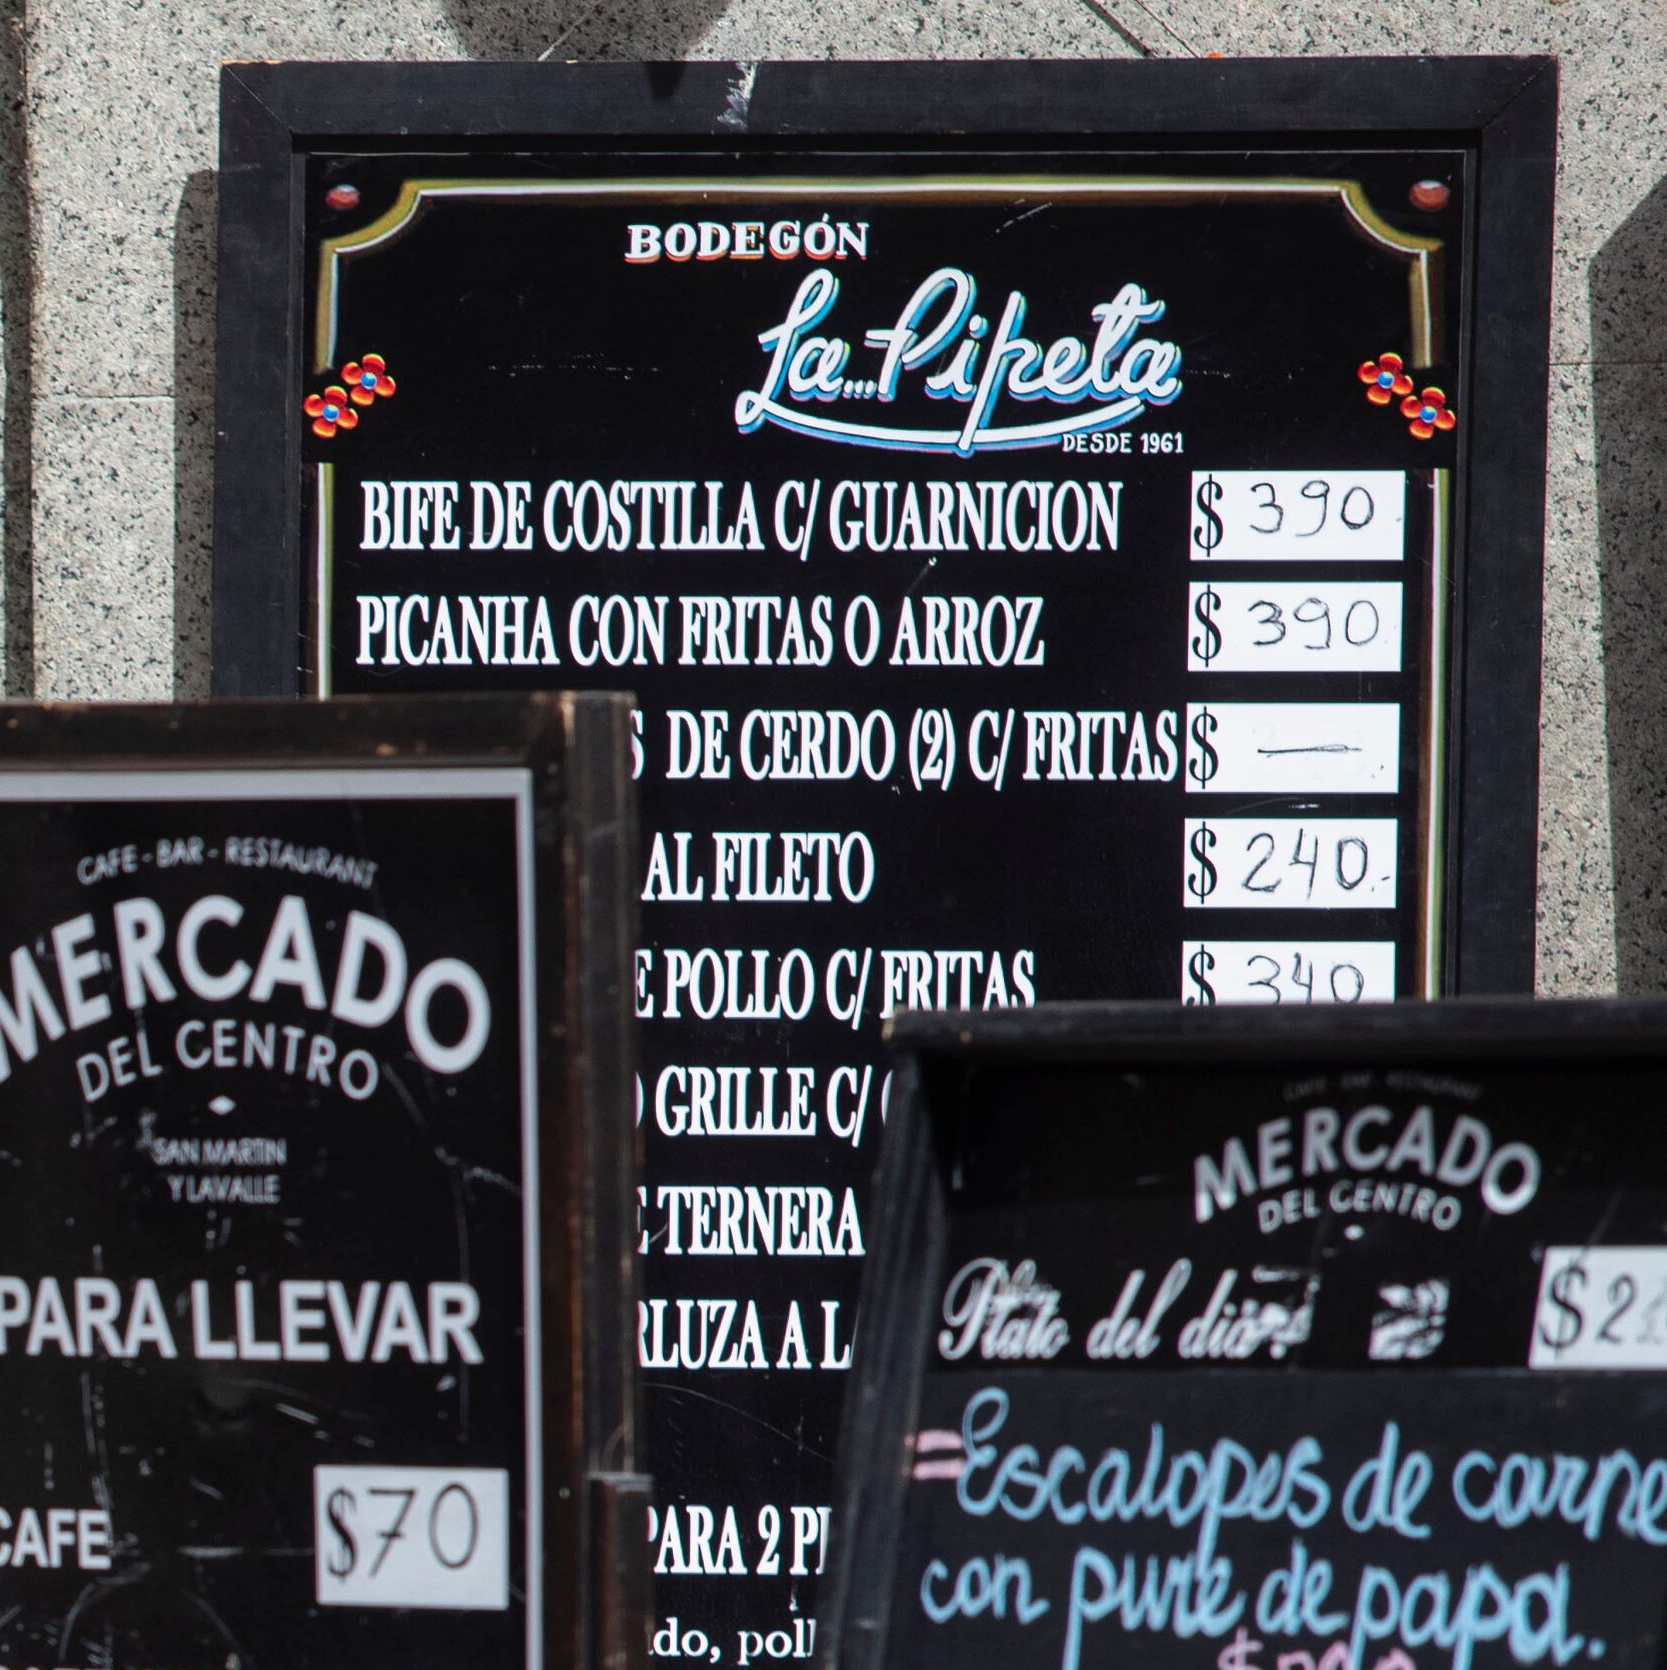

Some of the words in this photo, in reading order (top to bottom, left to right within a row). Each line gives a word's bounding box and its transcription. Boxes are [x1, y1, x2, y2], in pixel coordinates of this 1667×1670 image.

[624, 212, 870, 264] BODEGÓN
[1063, 431, 1132, 454] DESDE
[1140, 431, 1185, 454] 1961
[358, 477, 462, 554] BIFE
[468, 478, 535, 553] DE
[542, 477, 766, 555] COSTILLA
[772, 477, 823, 563] C/
[828, 477, 1125, 554] GUARNICION
[1249, 478, 1376, 538] 390
[354, 592, 562, 667] PICANHA
[568, 594, 670, 668] CON
[677, 594, 835, 667] FRITAS
[843, 594, 883, 668] O
[887, 594, 1047, 667] ARROZ
[1247, 596, 1381, 650] 390
[665, 708, 731, 781] DE
[739, 708, 898, 783] CERDO
[907, 706, 957, 793] (2)
[968, 706, 1017, 793] C/
[1022, 708, 1180, 782] FRITAS
[76, 842, 140, 886] CAFE
[155, 836, 205, 869] BAR
[224, 835, 380, 890] RESTAURANT
[640, 829, 705, 903] AL
[711, 829, 877, 905] FILETO
[662, 948, 817, 1022] POLLO
[825, 946, 874, 1032] C/
[880, 948, 1037, 1019] FRITAS
[75, 1030, 166, 1104] DEL
[174, 1017, 380, 1101] CENTRO
[654, 1063, 818, 1138] GRILLE
[825, 1063, 874, 1149] C/
[151, 1136, 200, 1167] SAN
[167, 1175, 185, 1203] Y
[185, 1175, 282, 1204] LAVALLE
[1192, 1102, 1544, 1225] MERCADO
[656, 1185, 868, 1258] TERNERA
[1256, 1185, 1322, 1236] DEL
[1328, 1177, 1464, 1233] CENTRO
[190, 1278, 486, 1366] LLEVAR
[774, 1299, 814, 1371] A
[1085, 1257, 1194, 1361] del
[956, 1387, 1330, 1584] Escalopes
[1342, 1419, 1433, 1541] de
[1452, 1447, 1667, 1547] carne
[325, 1481, 481, 1584] $70
[756, 1503, 783, 1577] 2
[920, 1553, 1051, 1626] con
[1255, 1537, 1349, 1640] de
